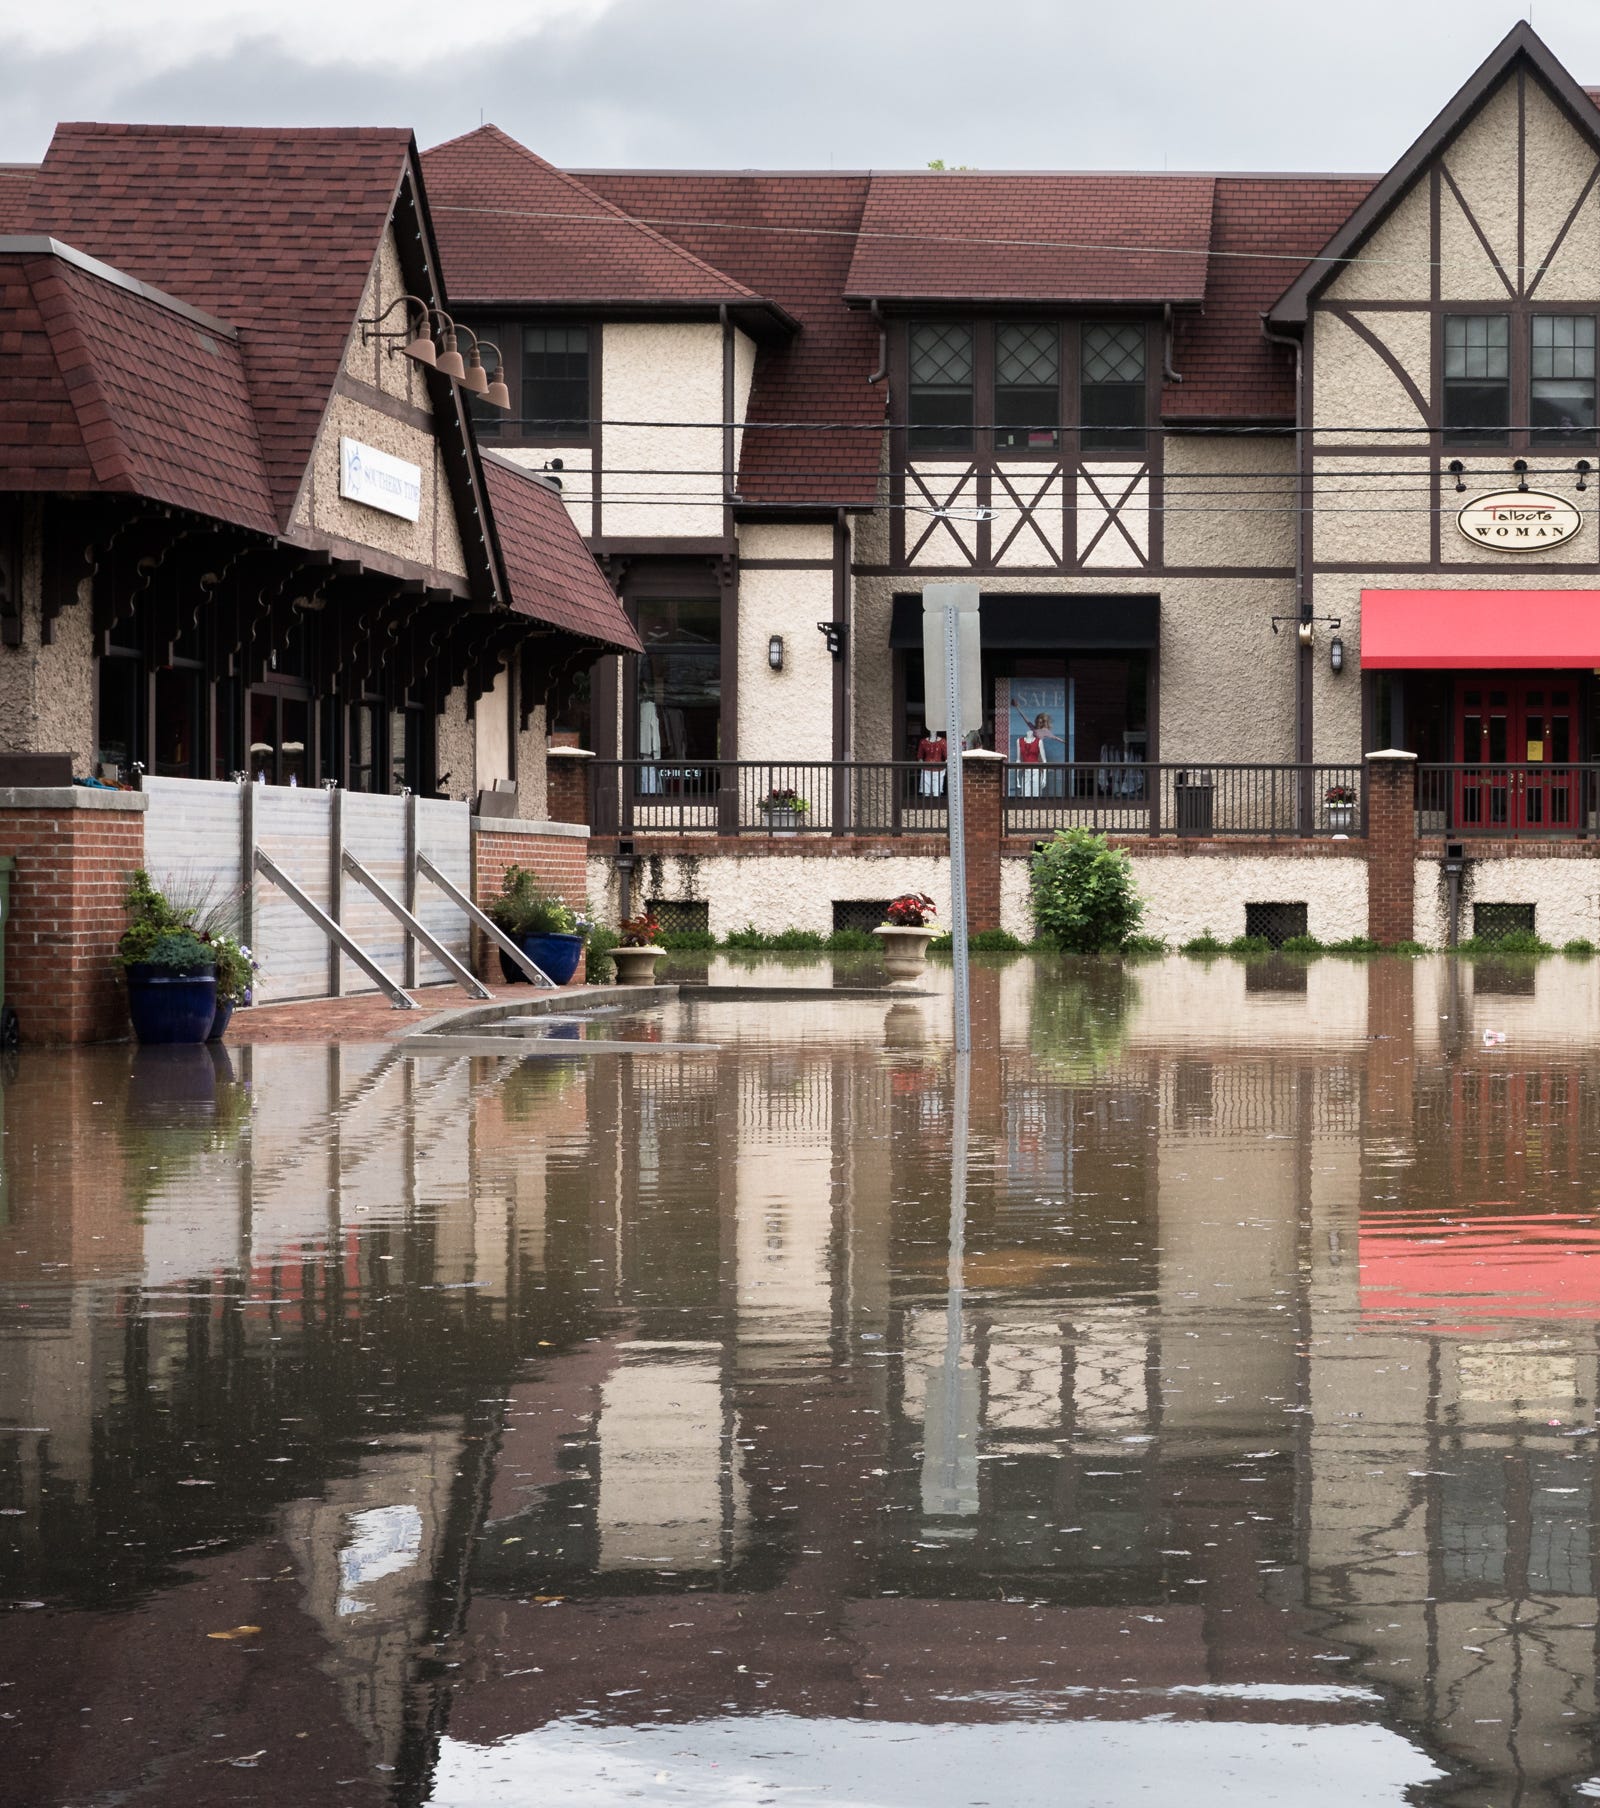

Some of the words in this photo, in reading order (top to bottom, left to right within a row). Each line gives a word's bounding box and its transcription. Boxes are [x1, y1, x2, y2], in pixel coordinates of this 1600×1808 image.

[1483, 504, 1556, 521] Talbots
[1475, 527, 1564, 537] WOMAN
[1017, 691, 1065, 707] SALE
